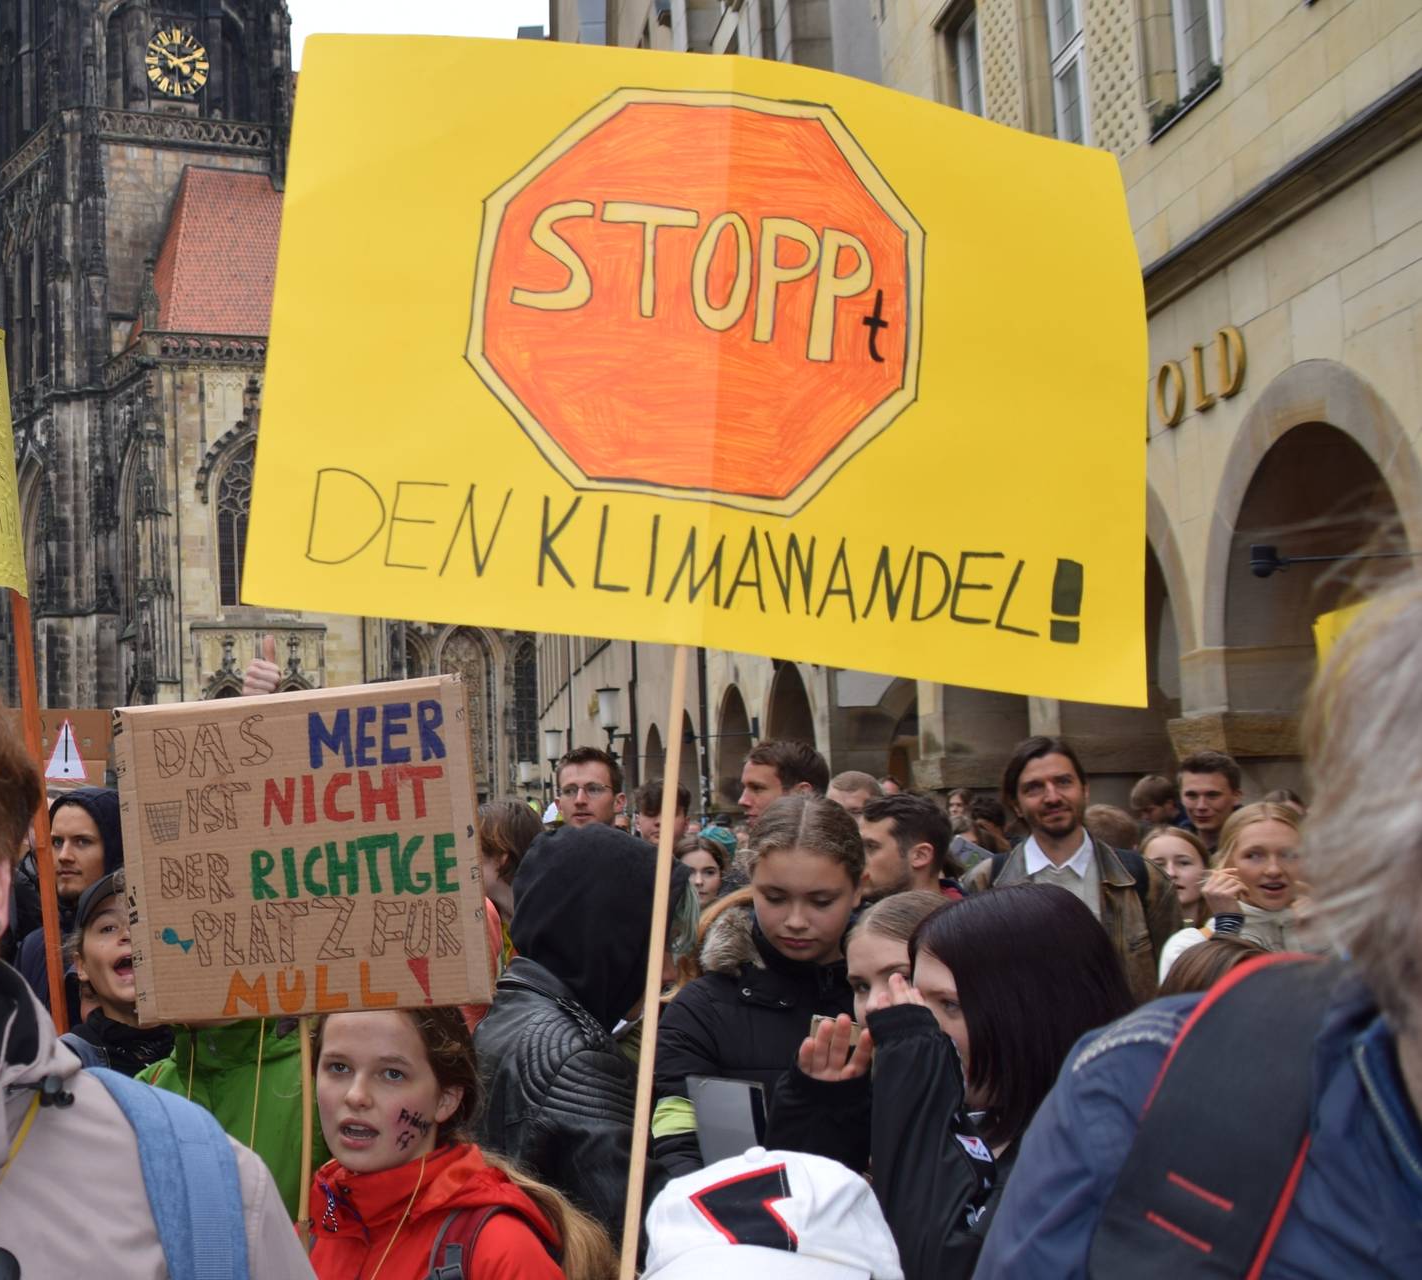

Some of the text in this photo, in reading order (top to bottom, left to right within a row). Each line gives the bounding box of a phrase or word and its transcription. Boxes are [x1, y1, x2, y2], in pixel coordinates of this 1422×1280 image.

[510, 200, 889, 365] STOPPt
[1147, 325, 1247, 443] OLD
[305, 467, 1085, 645] DEN KLIMAWANDEL!
[153, 714, 274, 778] DAS
[307, 699, 447, 769] MEER
[186, 765, 444, 833] IST NICHT
[160, 832, 461, 903] DER RICHTIGE
[192, 897, 356, 967] PLATZ
[370, 897, 462, 960] FÜR
